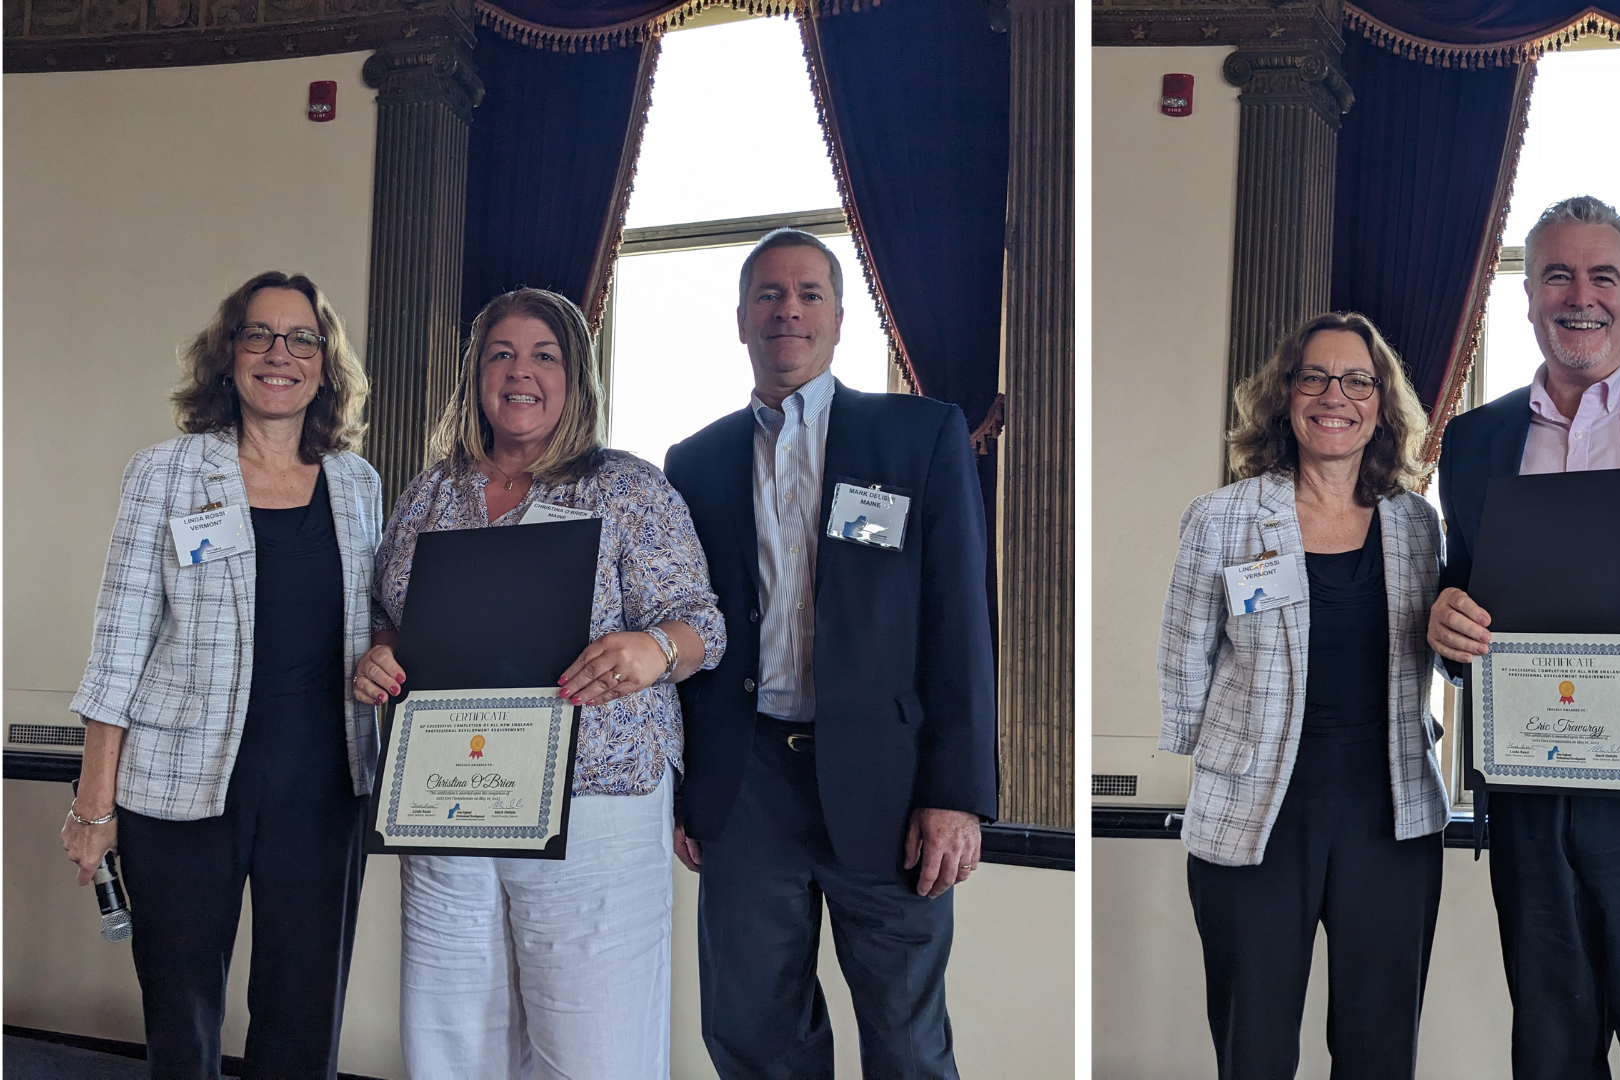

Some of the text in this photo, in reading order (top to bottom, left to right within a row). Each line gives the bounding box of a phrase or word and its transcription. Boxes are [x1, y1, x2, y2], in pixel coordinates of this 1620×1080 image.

[849, 488, 868, 497] MARK
[534, 503, 563, 513] CHRISTINA
[860, 499, 881, 509] MAINE
[183, 511, 225, 525] LINDA ROSSI
[190, 520, 222, 531] VERMONT
[1531, 657, 1596, 667] CERTIFICATE
[449, 711, 510, 722] CERTIFICATE
[1526, 716, 1605, 738] Eric Treworgy
[426, 773, 516, 789] Christina O'Brien
